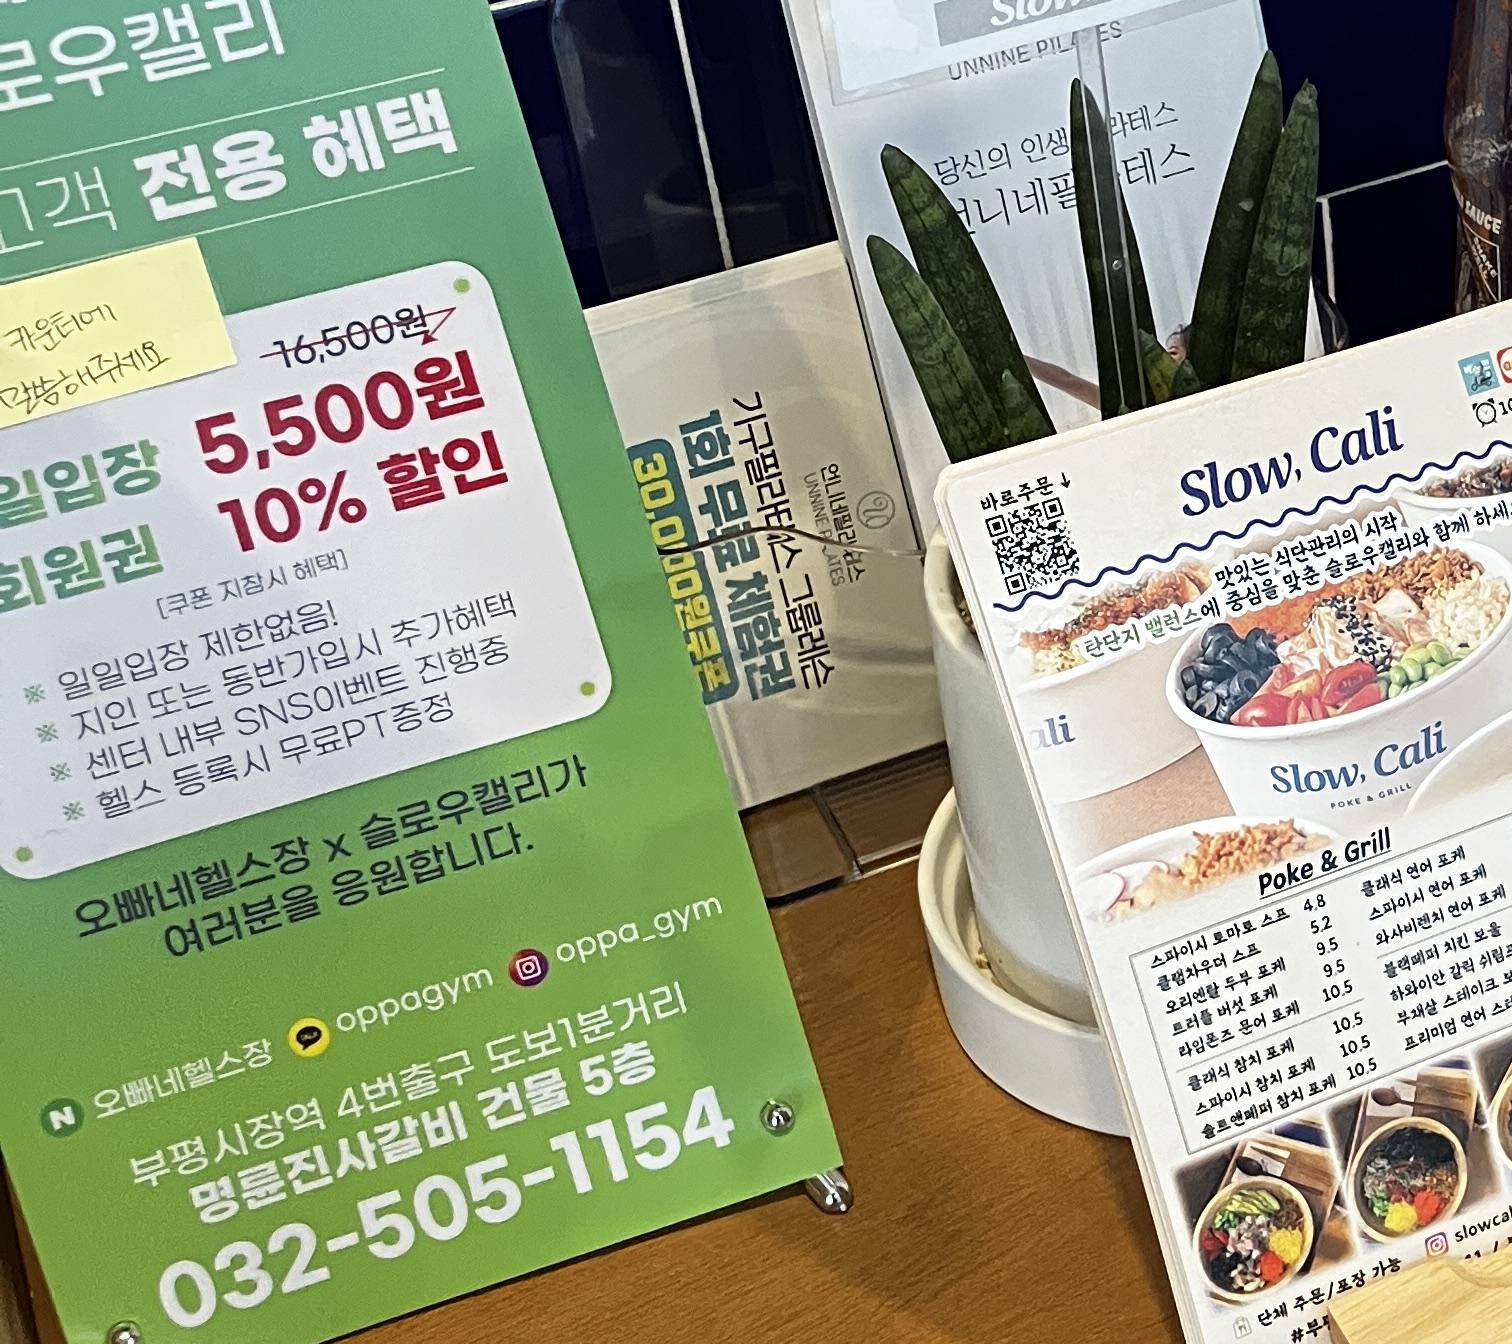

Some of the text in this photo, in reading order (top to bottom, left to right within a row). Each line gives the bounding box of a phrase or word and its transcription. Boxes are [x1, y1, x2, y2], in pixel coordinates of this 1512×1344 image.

[949, 43, 1031, 80] UNNINE
[133, 88, 458, 221] 전용 혜택
[934, 127, 1070, 185] 당신의 인생
[272, 305, 430, 369] 16,500원
[195, 350, 484, 475] 5,500원
[217, 430, 508, 552] 10% 할인
[980, 476, 1054, 510] 바로주문
[1180, 405, 1403, 516] Slow, Cali
[222, 563, 288, 600] 지참시
[679, 409, 736, 479] 1회
[725, 571, 797, 701] 체험권
[1084, 625, 1140, 657] 탄단지
[1146, 597, 1221, 637] 밸런스에
[1225, 579, 1278, 611] 중심을
[1283, 568, 1321, 595] 맞춘
[1325, 531, 1429, 578] 슬로우캘리와
[1434, 516, 1469, 542] 함께
[1215, 511, 1397, 589] 맛있는 식단관리의 시작
[58, 600, 338, 701] 일일입장 제한없음!
[71, 591, 517, 741] 지인 또는 동반가입시 추가혜택
[779, 574, 835, 689] 그룹레슨
[85, 634, 510, 780] 센터 내부 SNS이벤트 진행중
[97, 693, 455, 820] 헬스 등록시 무료PT증정
[1374, 720, 1448, 776] Cali
[1379, 782, 1412, 798] GRILL
[75, 754, 588, 939] 오빠네헬스장 슬로우캘리가
[1259, 826, 1392, 895] Poke & Grill
[1361, 869, 1402, 898] 클래식
[1407, 858, 1433, 880] 연어
[165, 824, 534, 959] 여러분을 응원합니다.
[556, 894, 723, 965] oppa_gym
[1376, 908, 1445, 946] 와사비렌치
[1151, 894, 1326, 969] 스파이시 토마토 스프 4.8
[1157, 916, 1333, 992] 클램차우더 스프 5.2
[1225, 937, 1338, 991] 두부 포케 9.5
[1444, 922, 1501, 953] 치킨 보울
[336, 964, 494, 1035] oppagym
[1172, 959, 1345, 1036] 트러플 버섯 포케 9.5
[1390, 970, 1446, 1001] 하와이안
[1449, 957, 1475, 980] 갈릭
[1443, 978, 1499, 1009] 스테이크
[1178, 980, 1353, 1058] 라임폰즈 문어 10.5
[1187, 1012, 1363, 1091] 클래식 참치 10.5
[1405, 1018, 1457, 1051] 프리미엄
[92, 1038, 273, 1119] 오빠네헬스장
[129, 981, 689, 1189] 부평시장역 4번출구 도보1분거리
[1195, 1082, 1252, 1116] 스파이시
[188, 1041, 656, 1225] 명륜진사갈비 건물 5층
[157, 1084, 735, 1328] 032-505-1154
[1257, 1302, 1288, 1326] 단체
[1373, 1256, 1402, 1280] 가능
